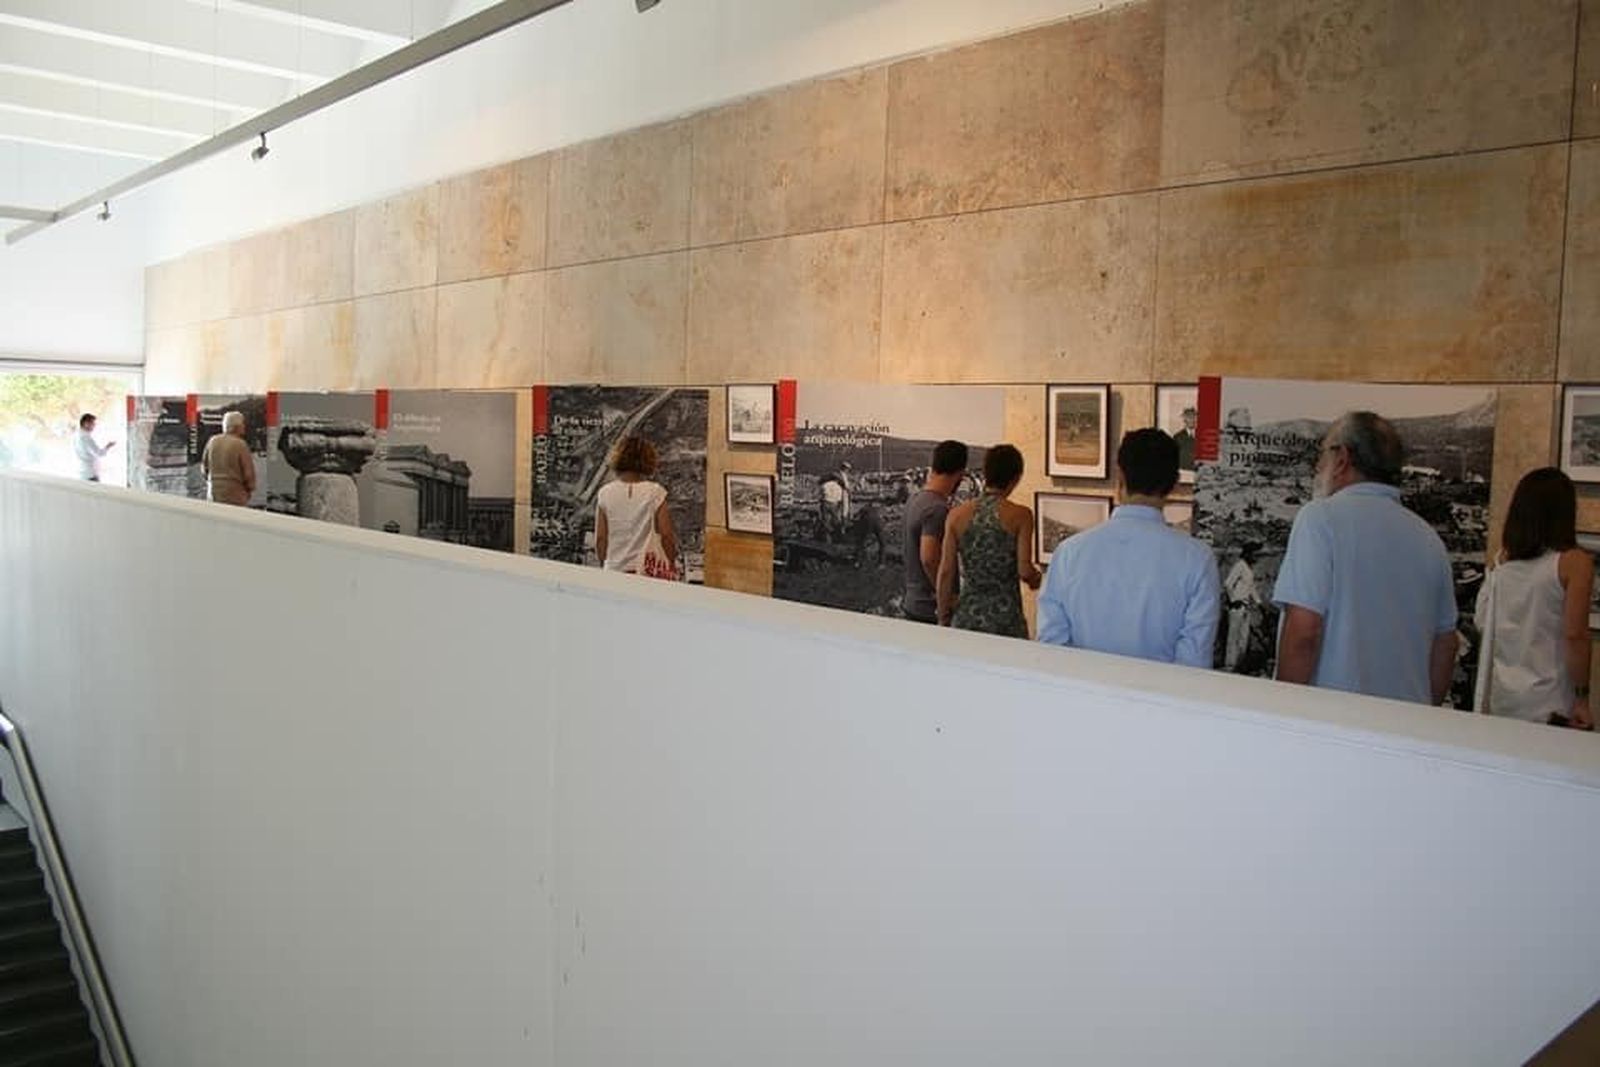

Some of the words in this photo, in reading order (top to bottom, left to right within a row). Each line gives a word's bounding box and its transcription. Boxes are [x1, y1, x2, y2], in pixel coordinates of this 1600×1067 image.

[801, 418, 820, 431] La
[803, 433, 881, 448] arqueológica
[781, 443, 796, 505] BAELO
